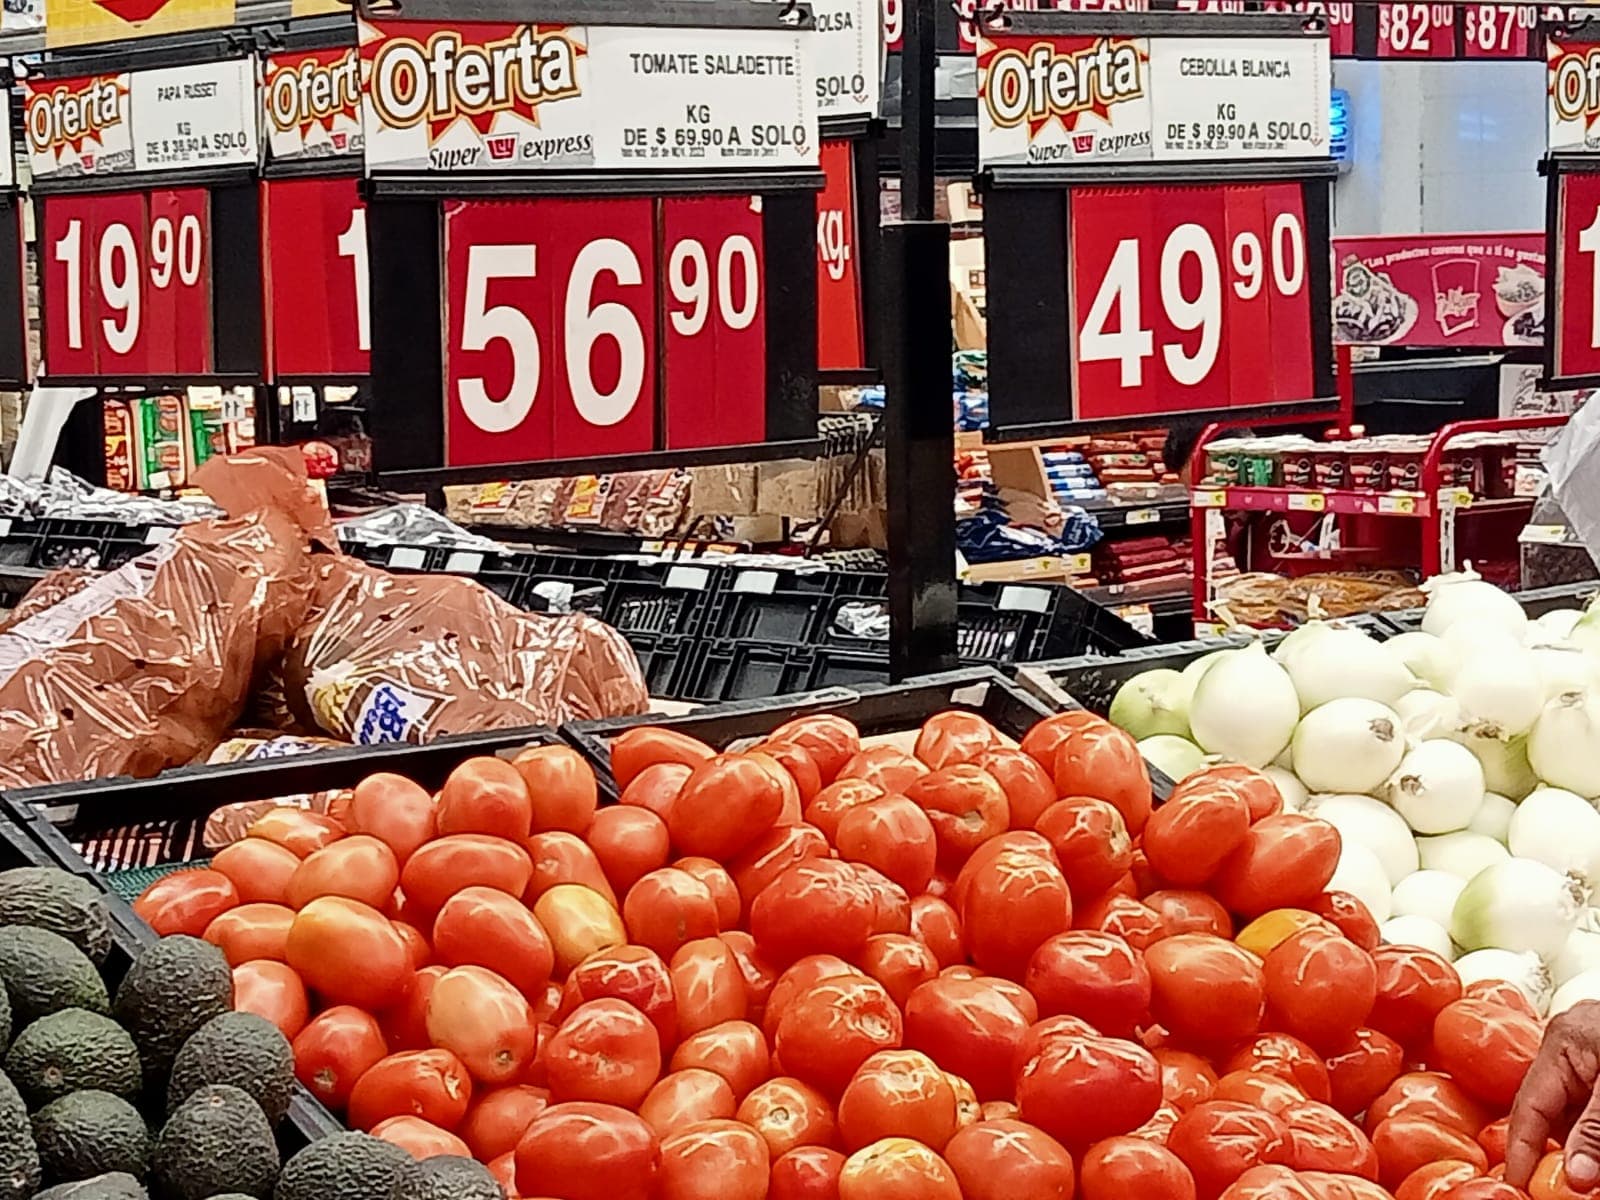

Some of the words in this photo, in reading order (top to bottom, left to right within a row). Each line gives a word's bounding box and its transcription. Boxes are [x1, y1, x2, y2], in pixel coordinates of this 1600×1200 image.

[374, 27, 579, 127] Oferta
[630, 53, 699, 74] TOMATE
[704, 54, 795, 76] SALADETTE
[1179, 57, 1238, 77] CEBOLLA
[1241, 59, 1291, 78] BLANCA
[815, 74, 865, 97] SOLO
[989, 40, 1141, 127] Oferta
[28, 78, 121, 150] Oferta
[686, 104, 711, 124] KG
[1216, 103, 1236, 121] KG
[213, 131, 247, 150] SOLO
[623, 128, 648, 146] DE
[656, 126, 667, 145] $
[674, 128, 724, 147] 69.90
[727, 126, 742, 146] A
[751, 125, 806, 147] SOLO
[1028, 143, 1068, 162] Super
[1098, 130, 1152, 154] express
[1167, 123, 1186, 140] DE
[1191, 122, 1201, 140] $
[1207, 123, 1246, 141] 89.90
[1248, 121, 1259, 140] A
[1266, 121, 1312, 141] SOLO
[428, 146, 481, 170] Super
[523, 133, 592, 161] express
[55, 219, 141, 354] 19
[150, 214, 202, 289] 90
[337, 208, 372, 351] 1
[1079, 222, 1223, 388] 49
[1231, 212, 1304, 300] 90
[457, 238, 646, 434] 56
[668, 234, 759, 336] 90
